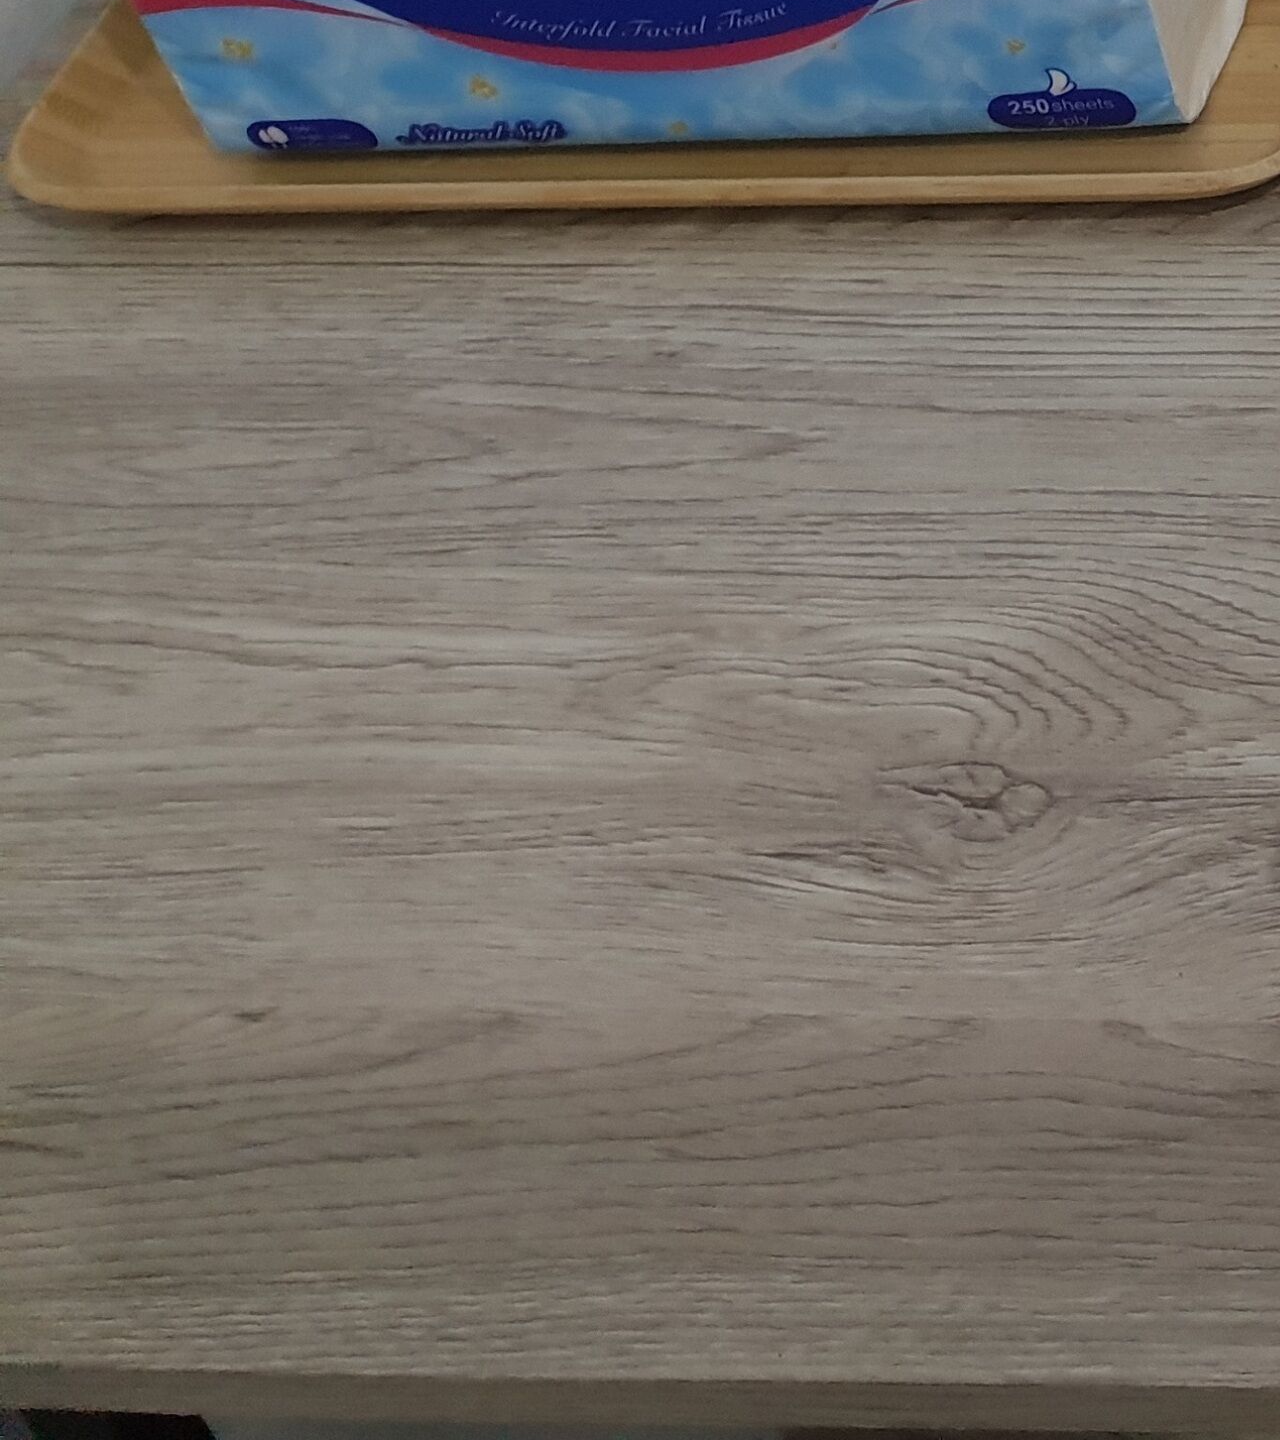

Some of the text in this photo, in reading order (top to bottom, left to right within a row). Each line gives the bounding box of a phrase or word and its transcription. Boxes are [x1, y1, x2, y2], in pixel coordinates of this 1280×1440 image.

[491, 2, 787, 41] Interfold Facial Tissue
[1008, 97, 1115, 115] 250 sheets
